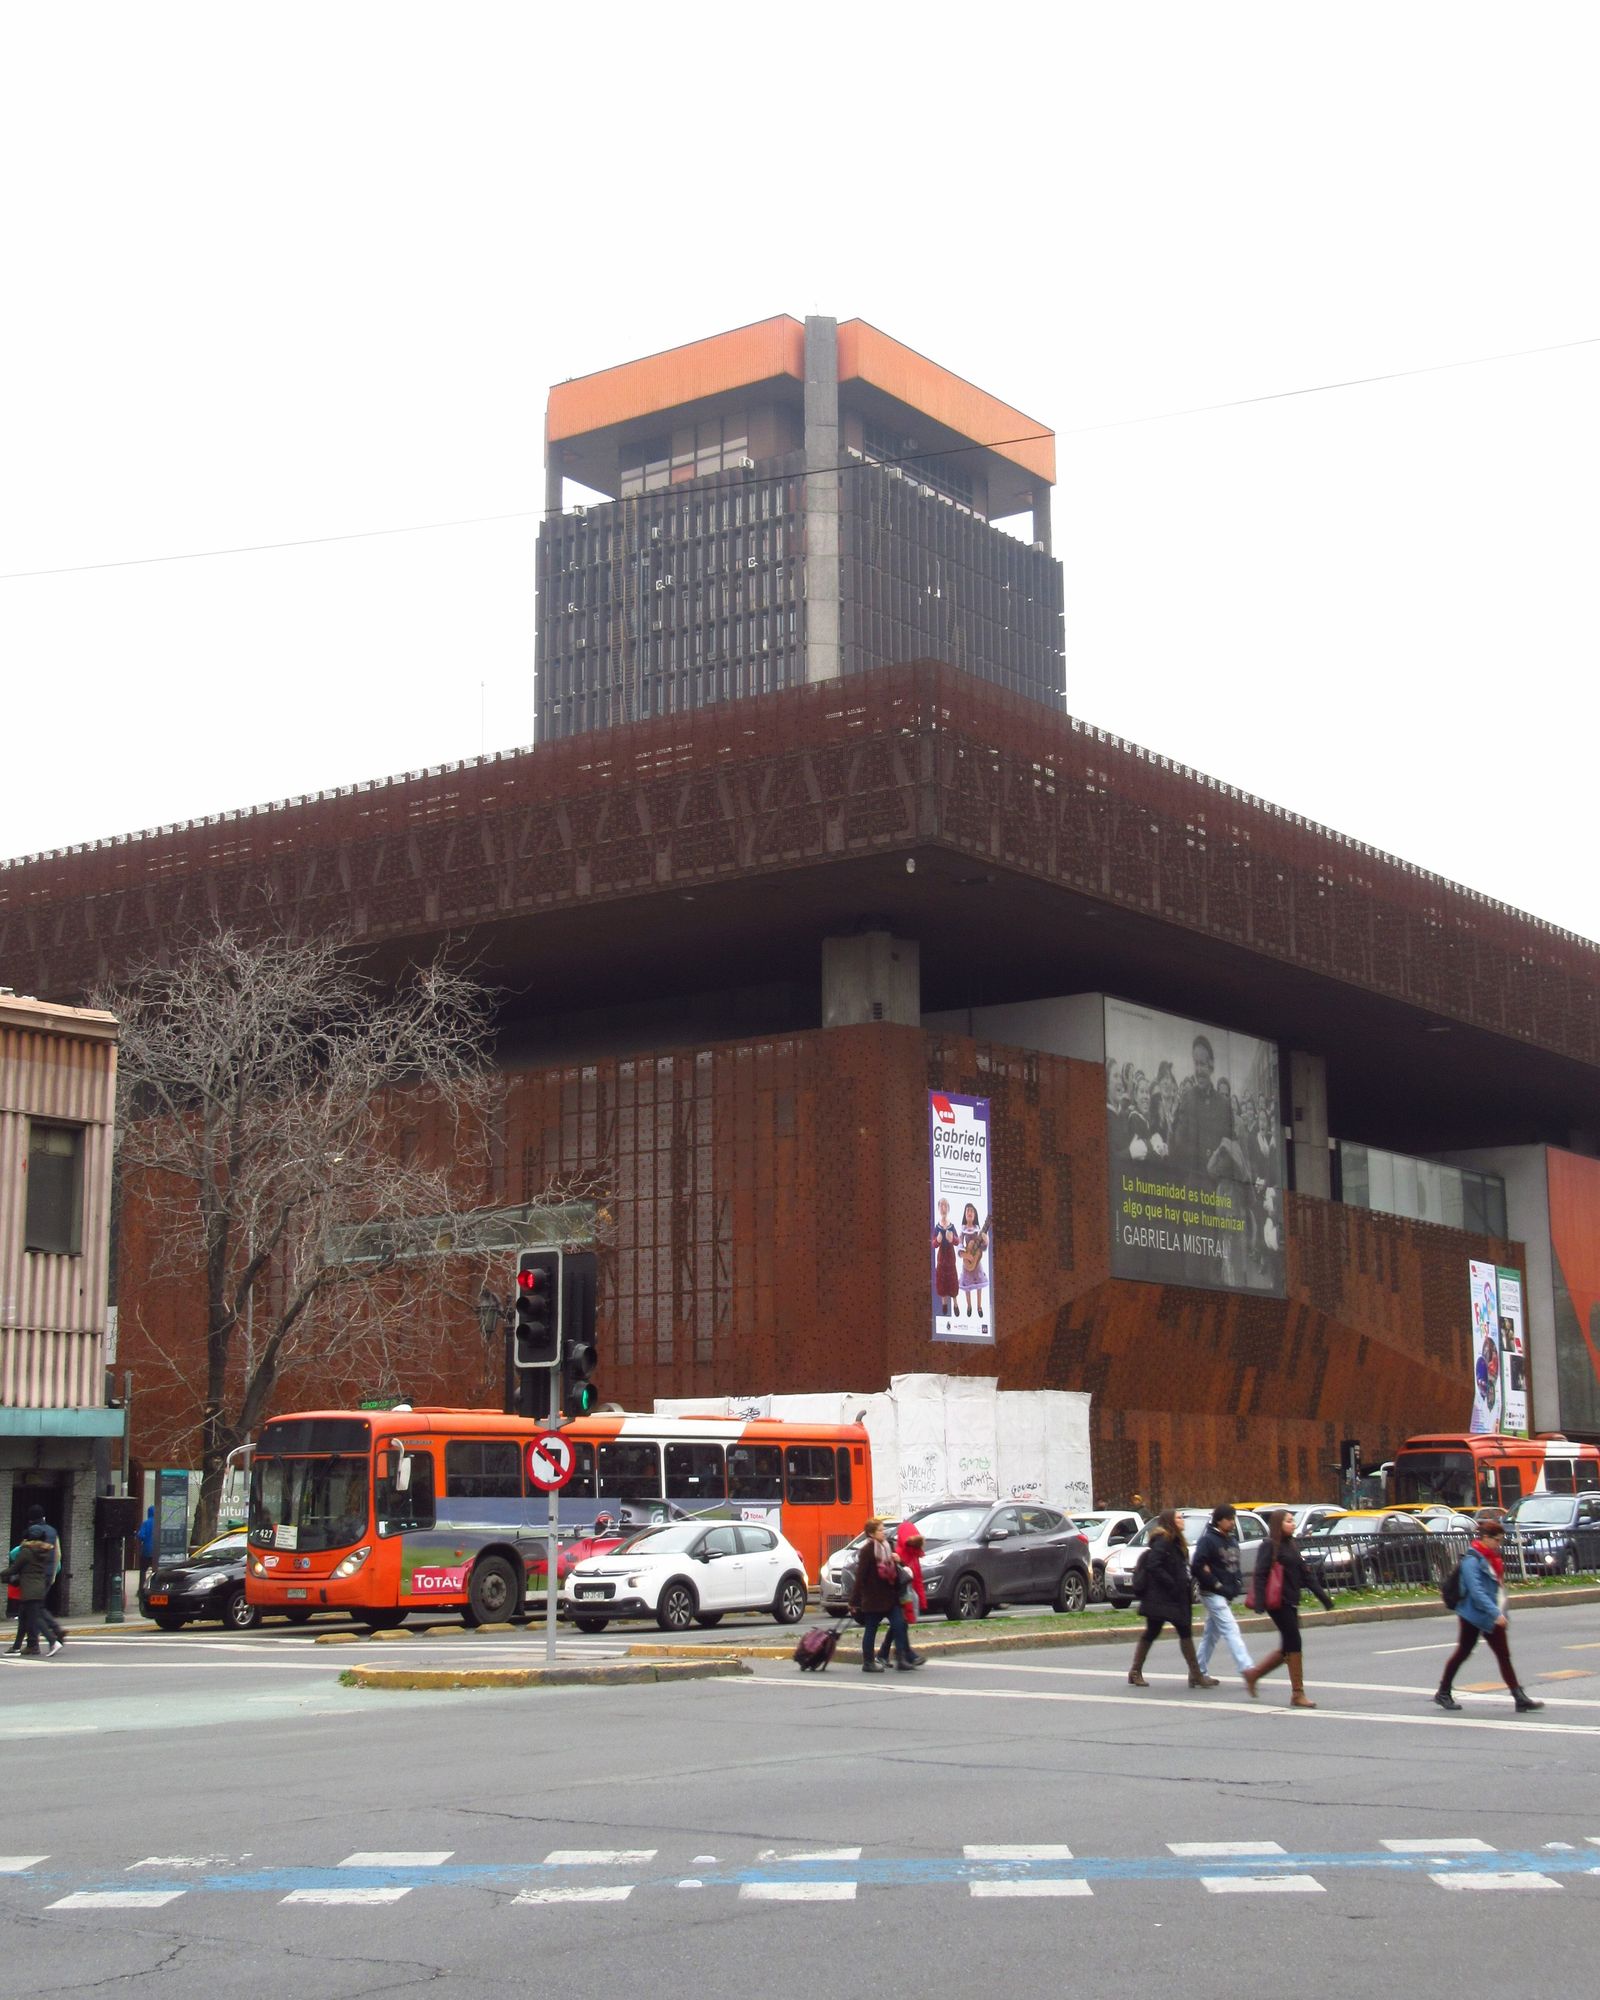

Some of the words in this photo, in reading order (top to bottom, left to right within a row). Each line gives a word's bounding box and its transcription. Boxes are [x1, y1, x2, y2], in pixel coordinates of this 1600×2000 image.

[933, 1125, 986, 1147] Gabriela
[933, 1143, 982, 1163] &Violeta
[1122, 1174, 1134, 1191] La
[1136, 1177, 1186, 1200] humanidad
[1188, 1190, 1199, 1202] es
[1123, 1198, 1142, 1218] algo
[1145, 1204, 1162, 1220] que
[1165, 1204, 1180, 1224] hay
[1183, 1210, 1199, 1226] que
[1202, 1211, 1245, 1231] humanizar
[1123, 1225, 1181, 1251] GABRIELA
[1183, 1233, 1229, 1259] MISTRAL
[908, 1465, 936, 1482] MACHOS
[260, 1529, 273, 1539] 427
[415, 1574, 462, 1589] TOTAL
